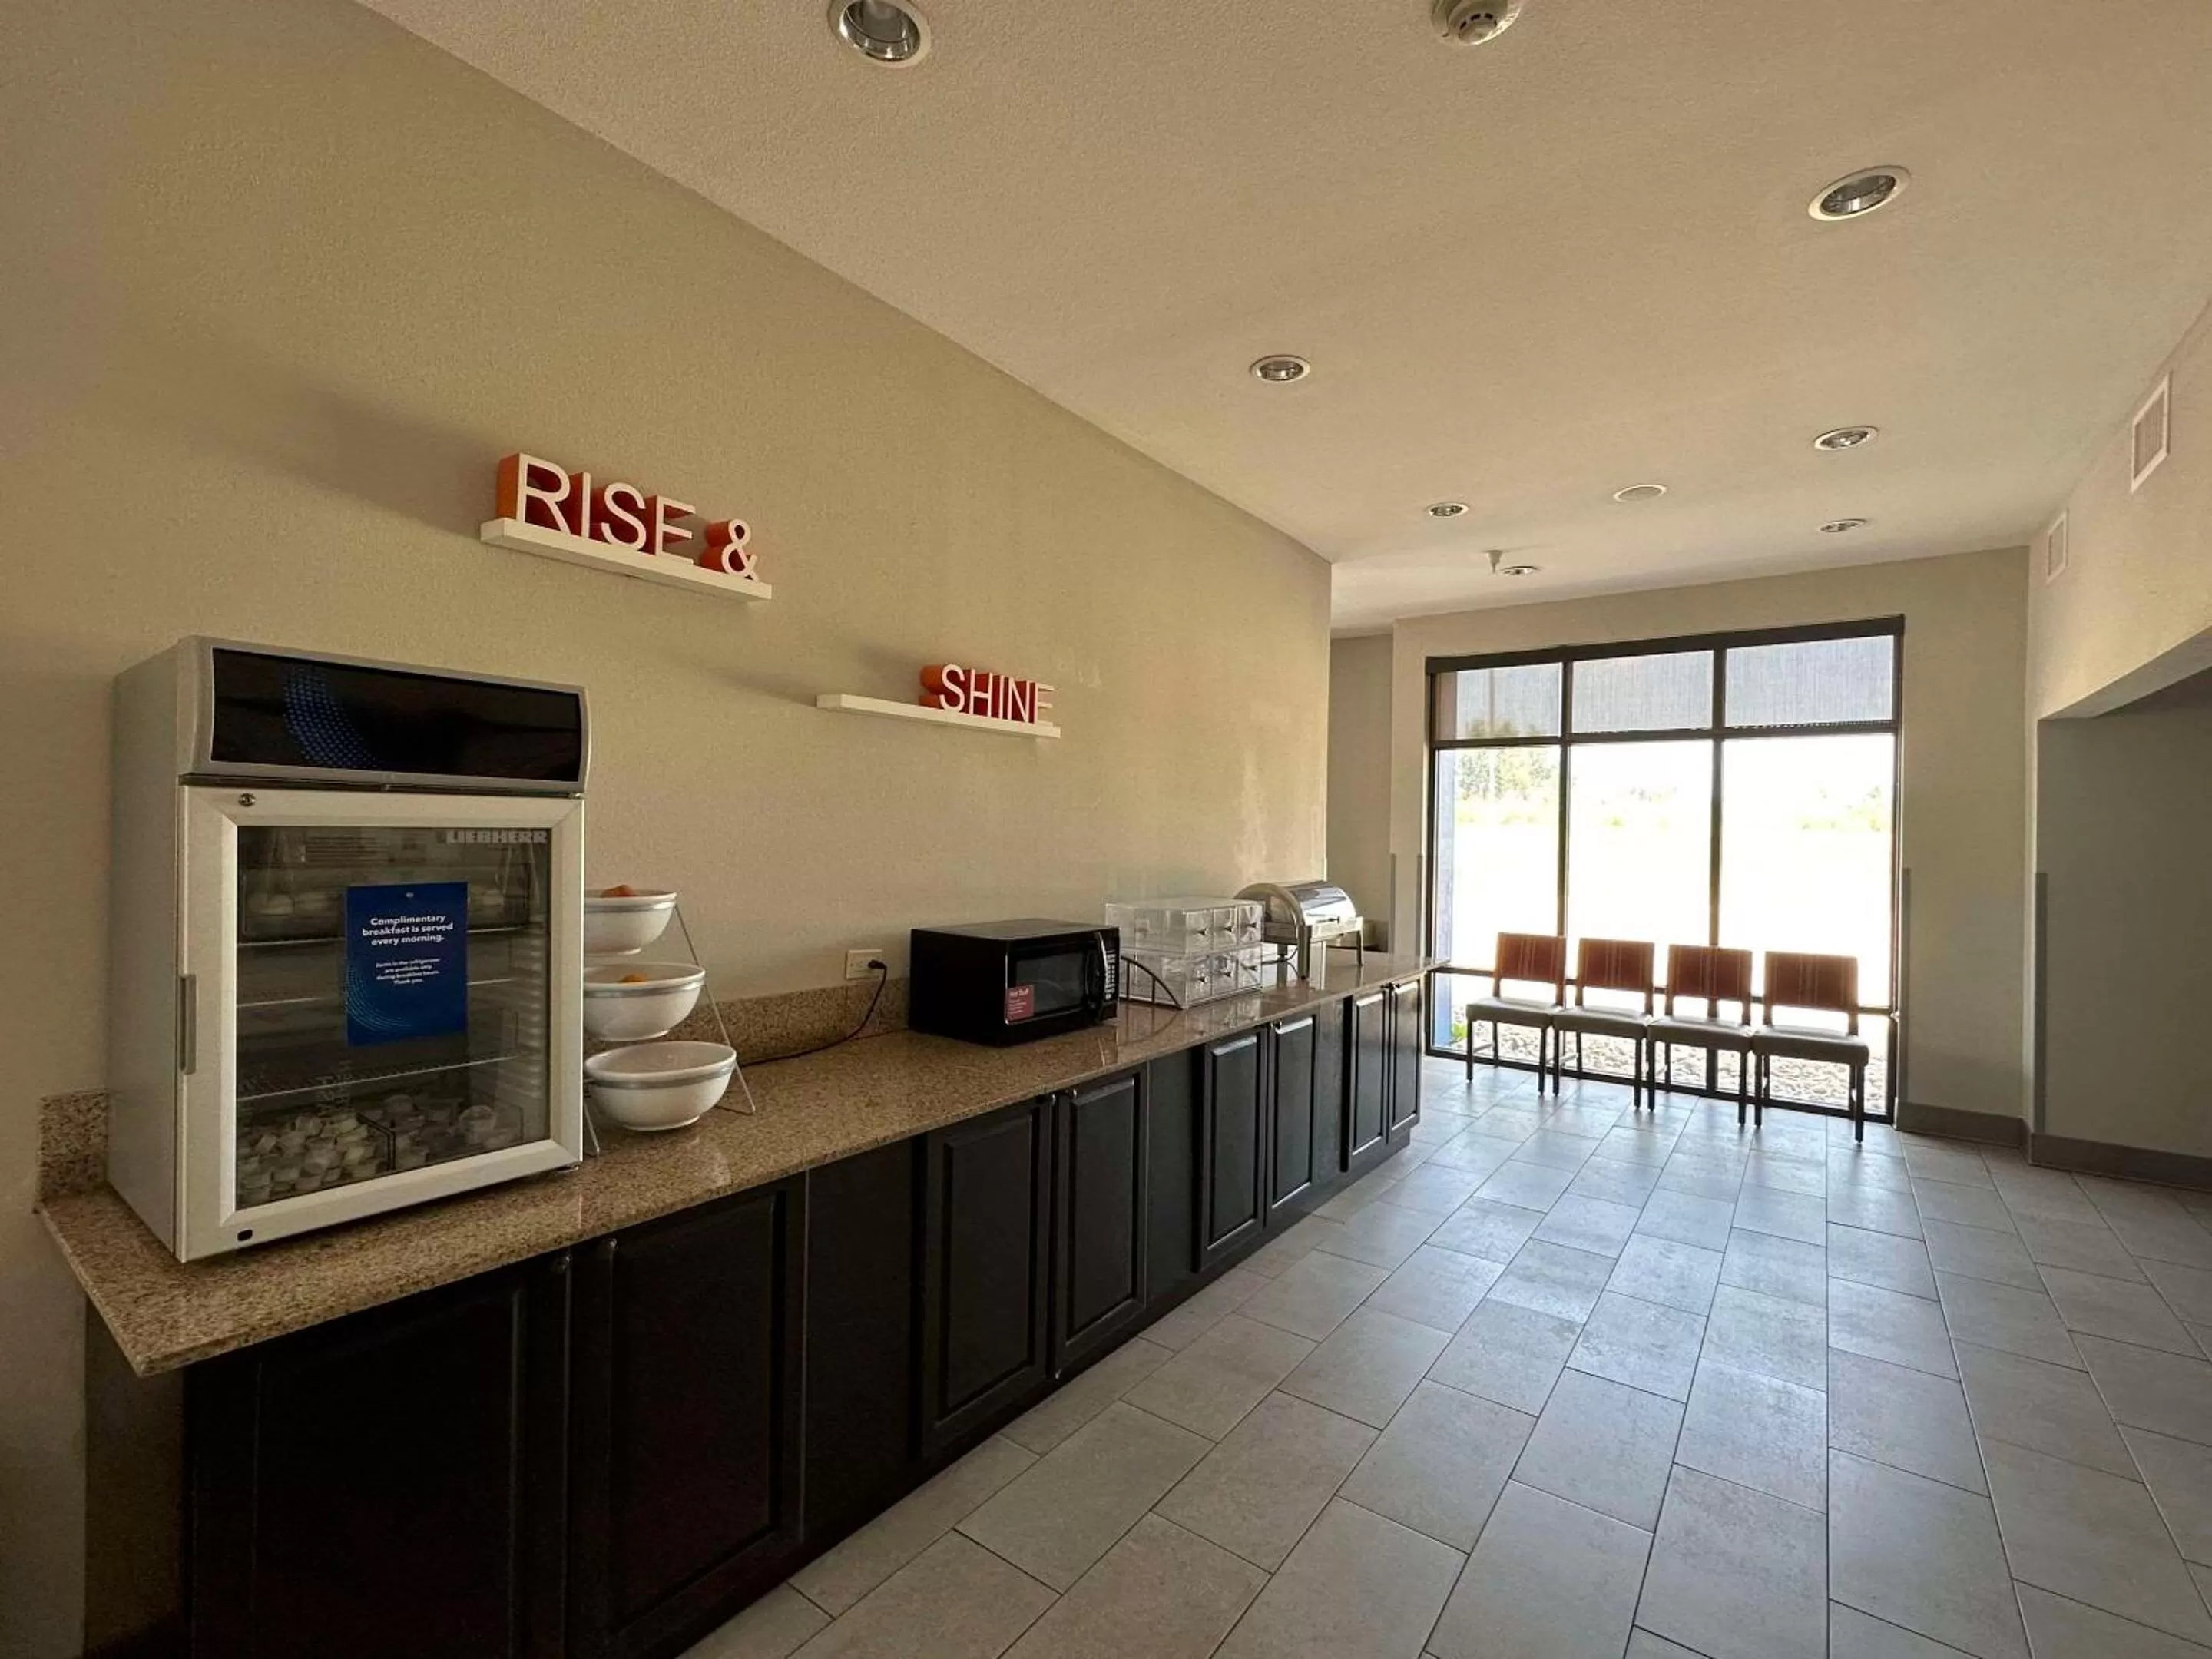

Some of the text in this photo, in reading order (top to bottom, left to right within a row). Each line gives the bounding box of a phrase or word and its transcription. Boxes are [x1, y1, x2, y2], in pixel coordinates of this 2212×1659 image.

[515, 452, 760, 583] RISE &
[939, 663, 1055, 729] SHINE
[445, 829, 548, 844] LIEBHERR
[370, 915, 446, 928] Complimentary
[362, 922, 454, 936] breakfast is served
[371, 934, 445, 946] every morning.
